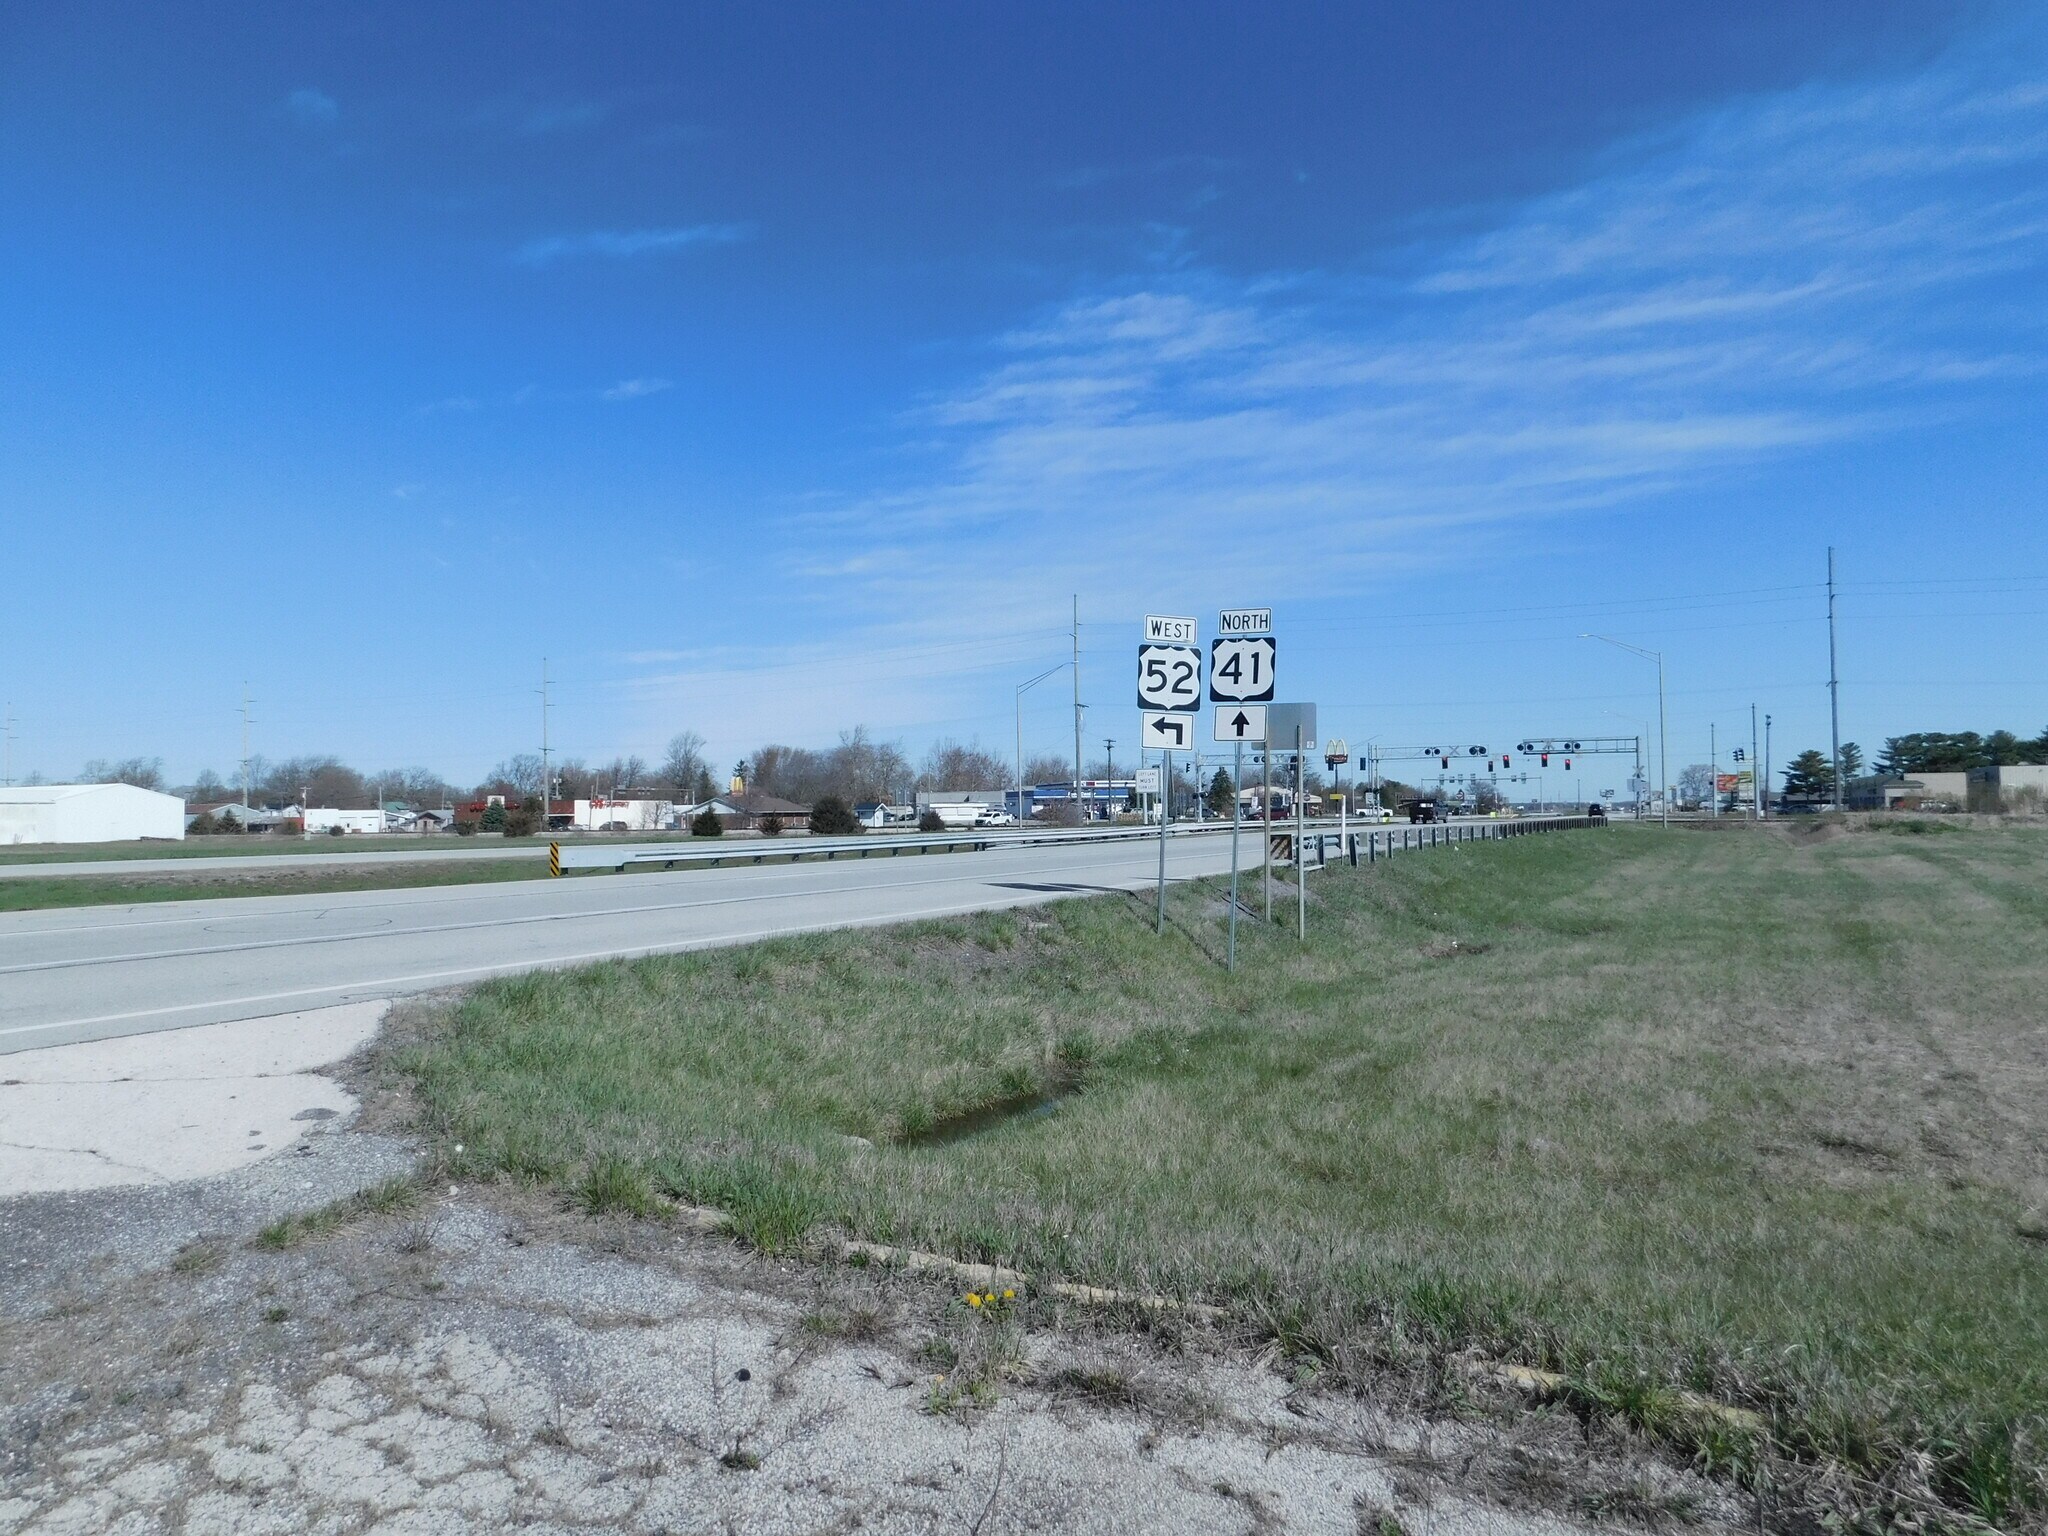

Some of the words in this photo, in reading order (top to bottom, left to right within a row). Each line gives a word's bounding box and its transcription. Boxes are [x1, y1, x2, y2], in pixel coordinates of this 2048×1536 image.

[1151, 620, 1191, 639] WEST
[1222, 614, 1268, 630] NORTH
[1146, 659, 1194, 694] 52
[1218, 651, 1260, 685] 41
